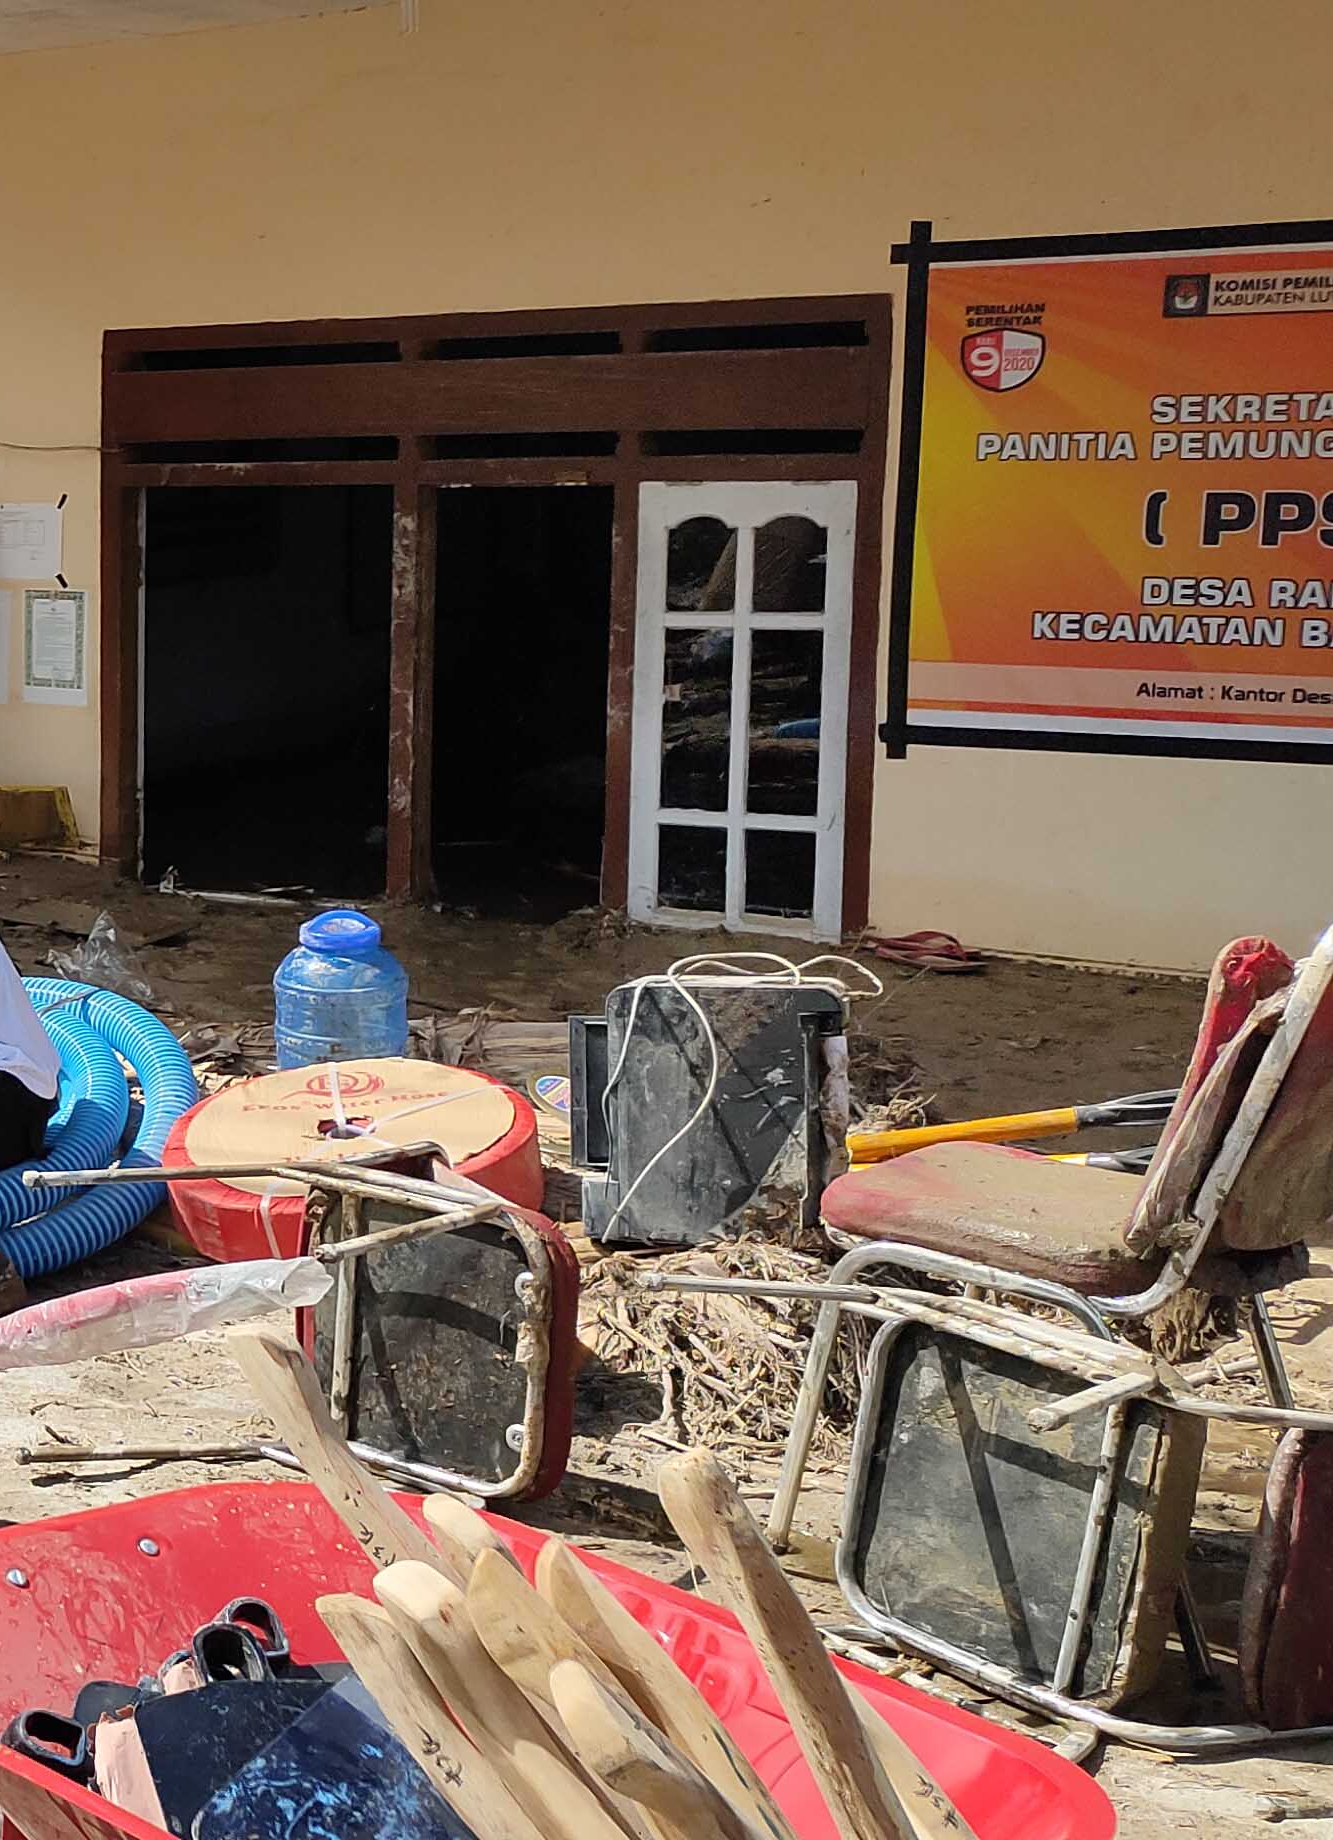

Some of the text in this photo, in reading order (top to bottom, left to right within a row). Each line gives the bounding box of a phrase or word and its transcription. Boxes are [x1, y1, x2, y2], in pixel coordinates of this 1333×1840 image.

[1213, 291, 1306, 306] KABUPATEN
[1215, 279, 1278, 293] KOMISI
[970, 346, 1000, 377] 9
[1004, 357, 1035, 371] 2020
[975, 432, 1137, 461] PANITIA
[1141, 577, 1333, 609] DESA RA
[1032, 610, 1333, 648] KECAMATAN B
[1136, 682, 1204, 701] Alamat
[1221, 685, 1286, 703] Kantor
